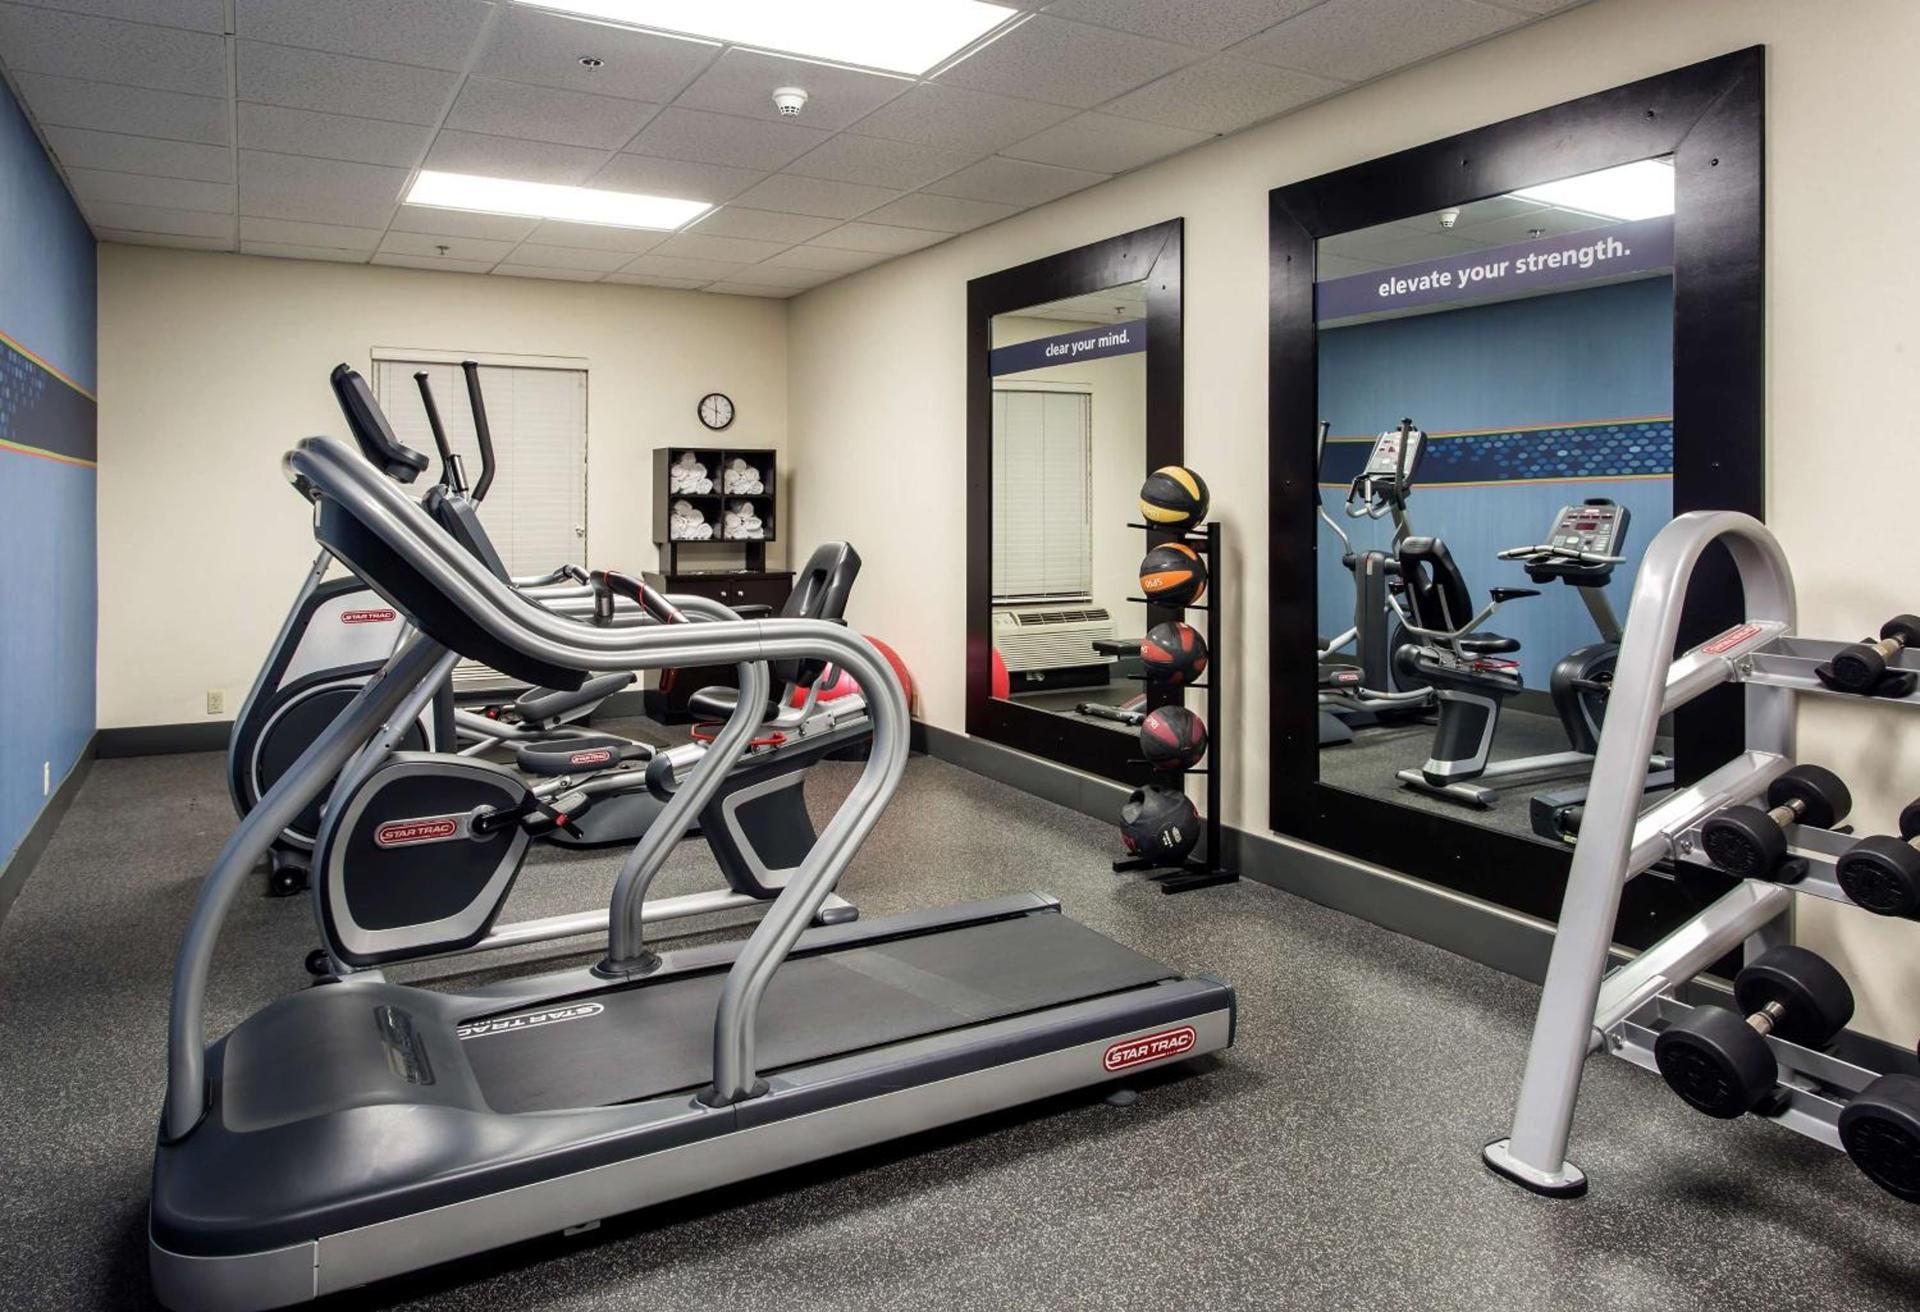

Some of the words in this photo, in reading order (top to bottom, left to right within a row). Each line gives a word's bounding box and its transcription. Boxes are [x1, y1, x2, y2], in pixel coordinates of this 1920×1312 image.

[1378, 271, 1451, 297] elevate
[1457, 261, 1510, 288] your
[1515, 236, 1631, 274] strength.
[1045, 343, 1069, 357] clear
[1071, 338, 1096, 356] your
[1098, 329, 1130, 347] mind.
[384, 828, 416, 839] STAR
[417, 824, 450, 835] TRAC
[529, 1006, 594, 1023] STAR
[457, 1018, 525, 1037] TRAC
[1111, 1045, 1149, 1061] STAR
[1150, 1034, 1189, 1053] TRAC
